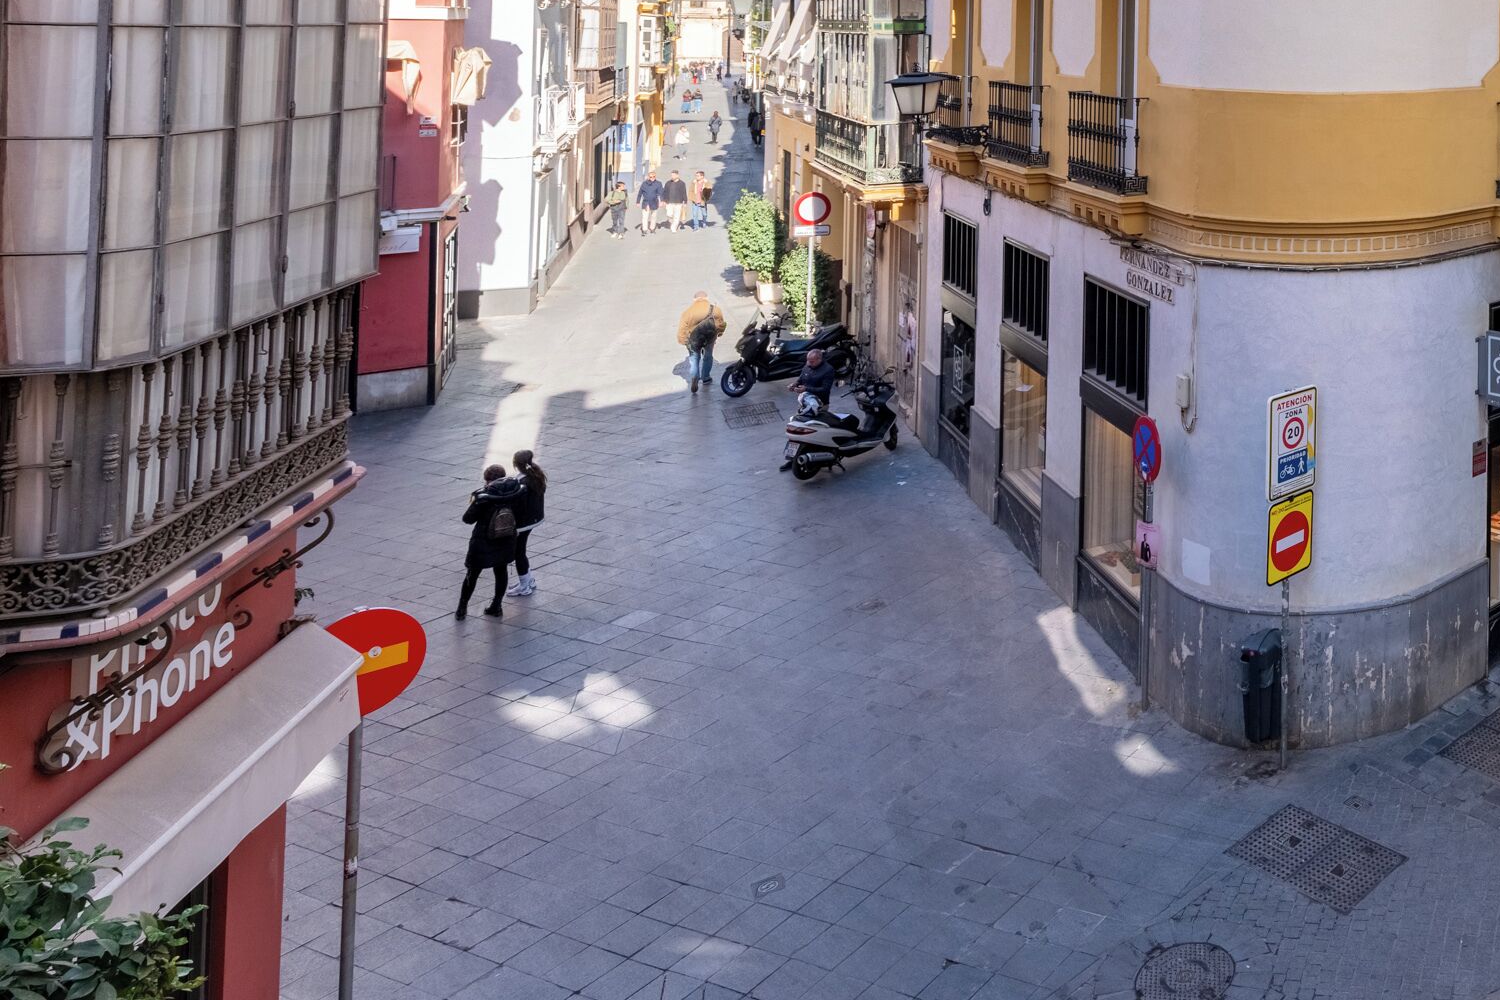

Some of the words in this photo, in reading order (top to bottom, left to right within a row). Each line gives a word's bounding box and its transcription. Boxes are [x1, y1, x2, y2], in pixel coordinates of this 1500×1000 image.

[1127, 271, 1172, 303] GONZALEZ
[1285, 408, 1303, 419] ZONA
[1287, 426, 1300, 440] 20
